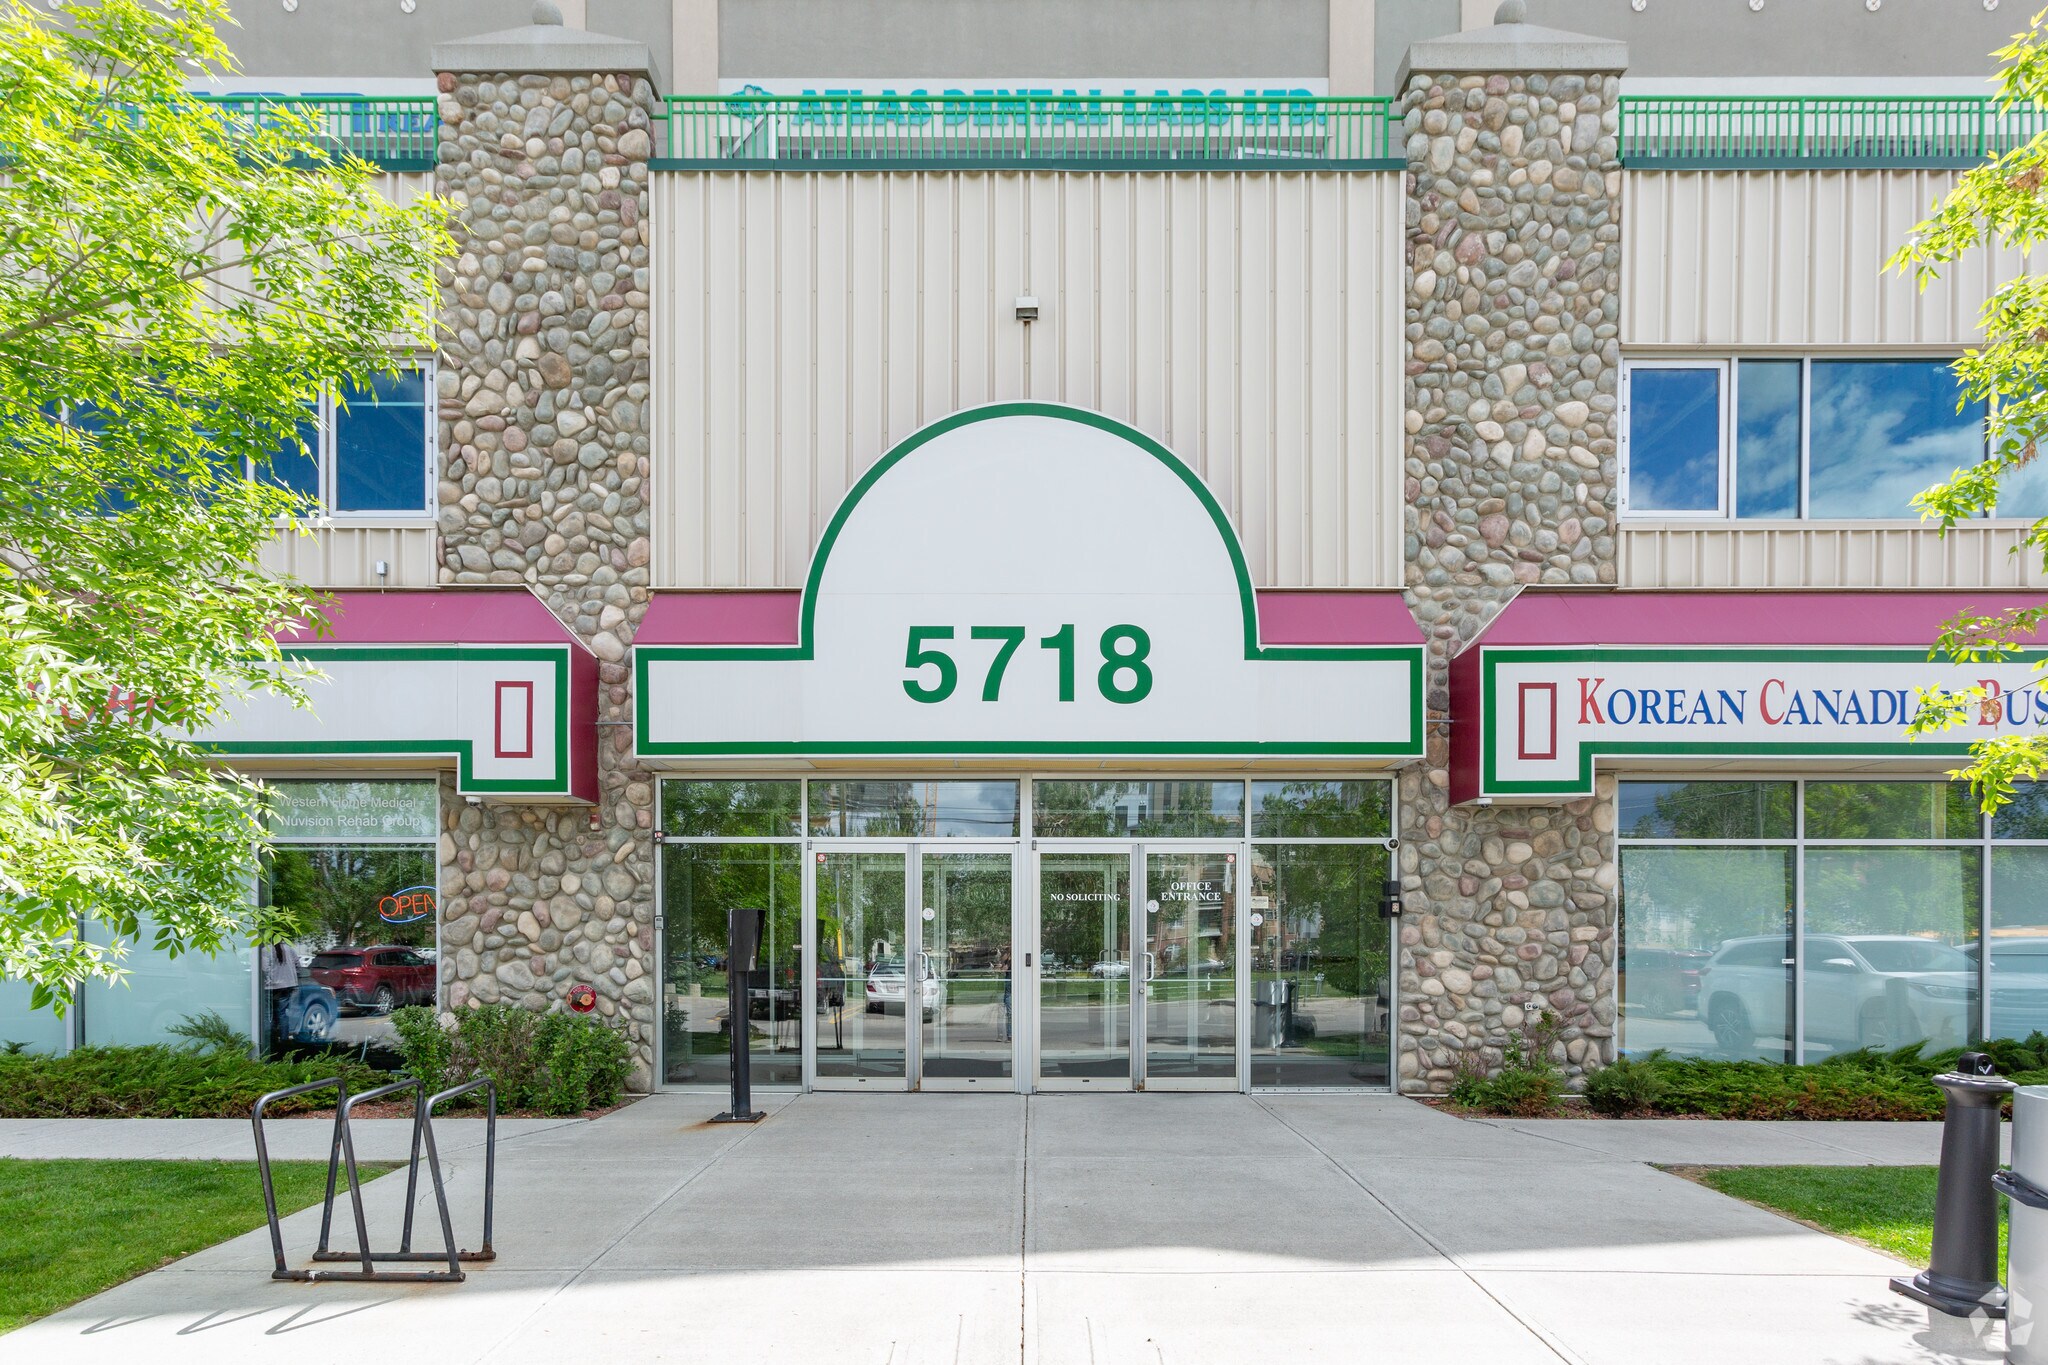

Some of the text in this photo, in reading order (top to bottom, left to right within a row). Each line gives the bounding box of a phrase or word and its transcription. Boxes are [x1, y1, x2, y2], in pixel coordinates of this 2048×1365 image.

[791, 88, 932, 126] ATLAS
[943, 88, 1109, 126] DENTAL
[1122, 88, 1230, 126] LABS
[902, 623, 1153, 704] 5718
[1577, 677, 1747, 725] KOREAN
[280, 797, 416, 808] Western Home Medical
[281, 815, 420, 830] Nuvision Rehab Group
[1170, 881, 1211, 891] OFFICE
[1050, 893, 1121, 901] NO SOLICITING
[1161, 891, 1221, 901] ENTRANCE
[378, 893, 436, 917] OPEN
